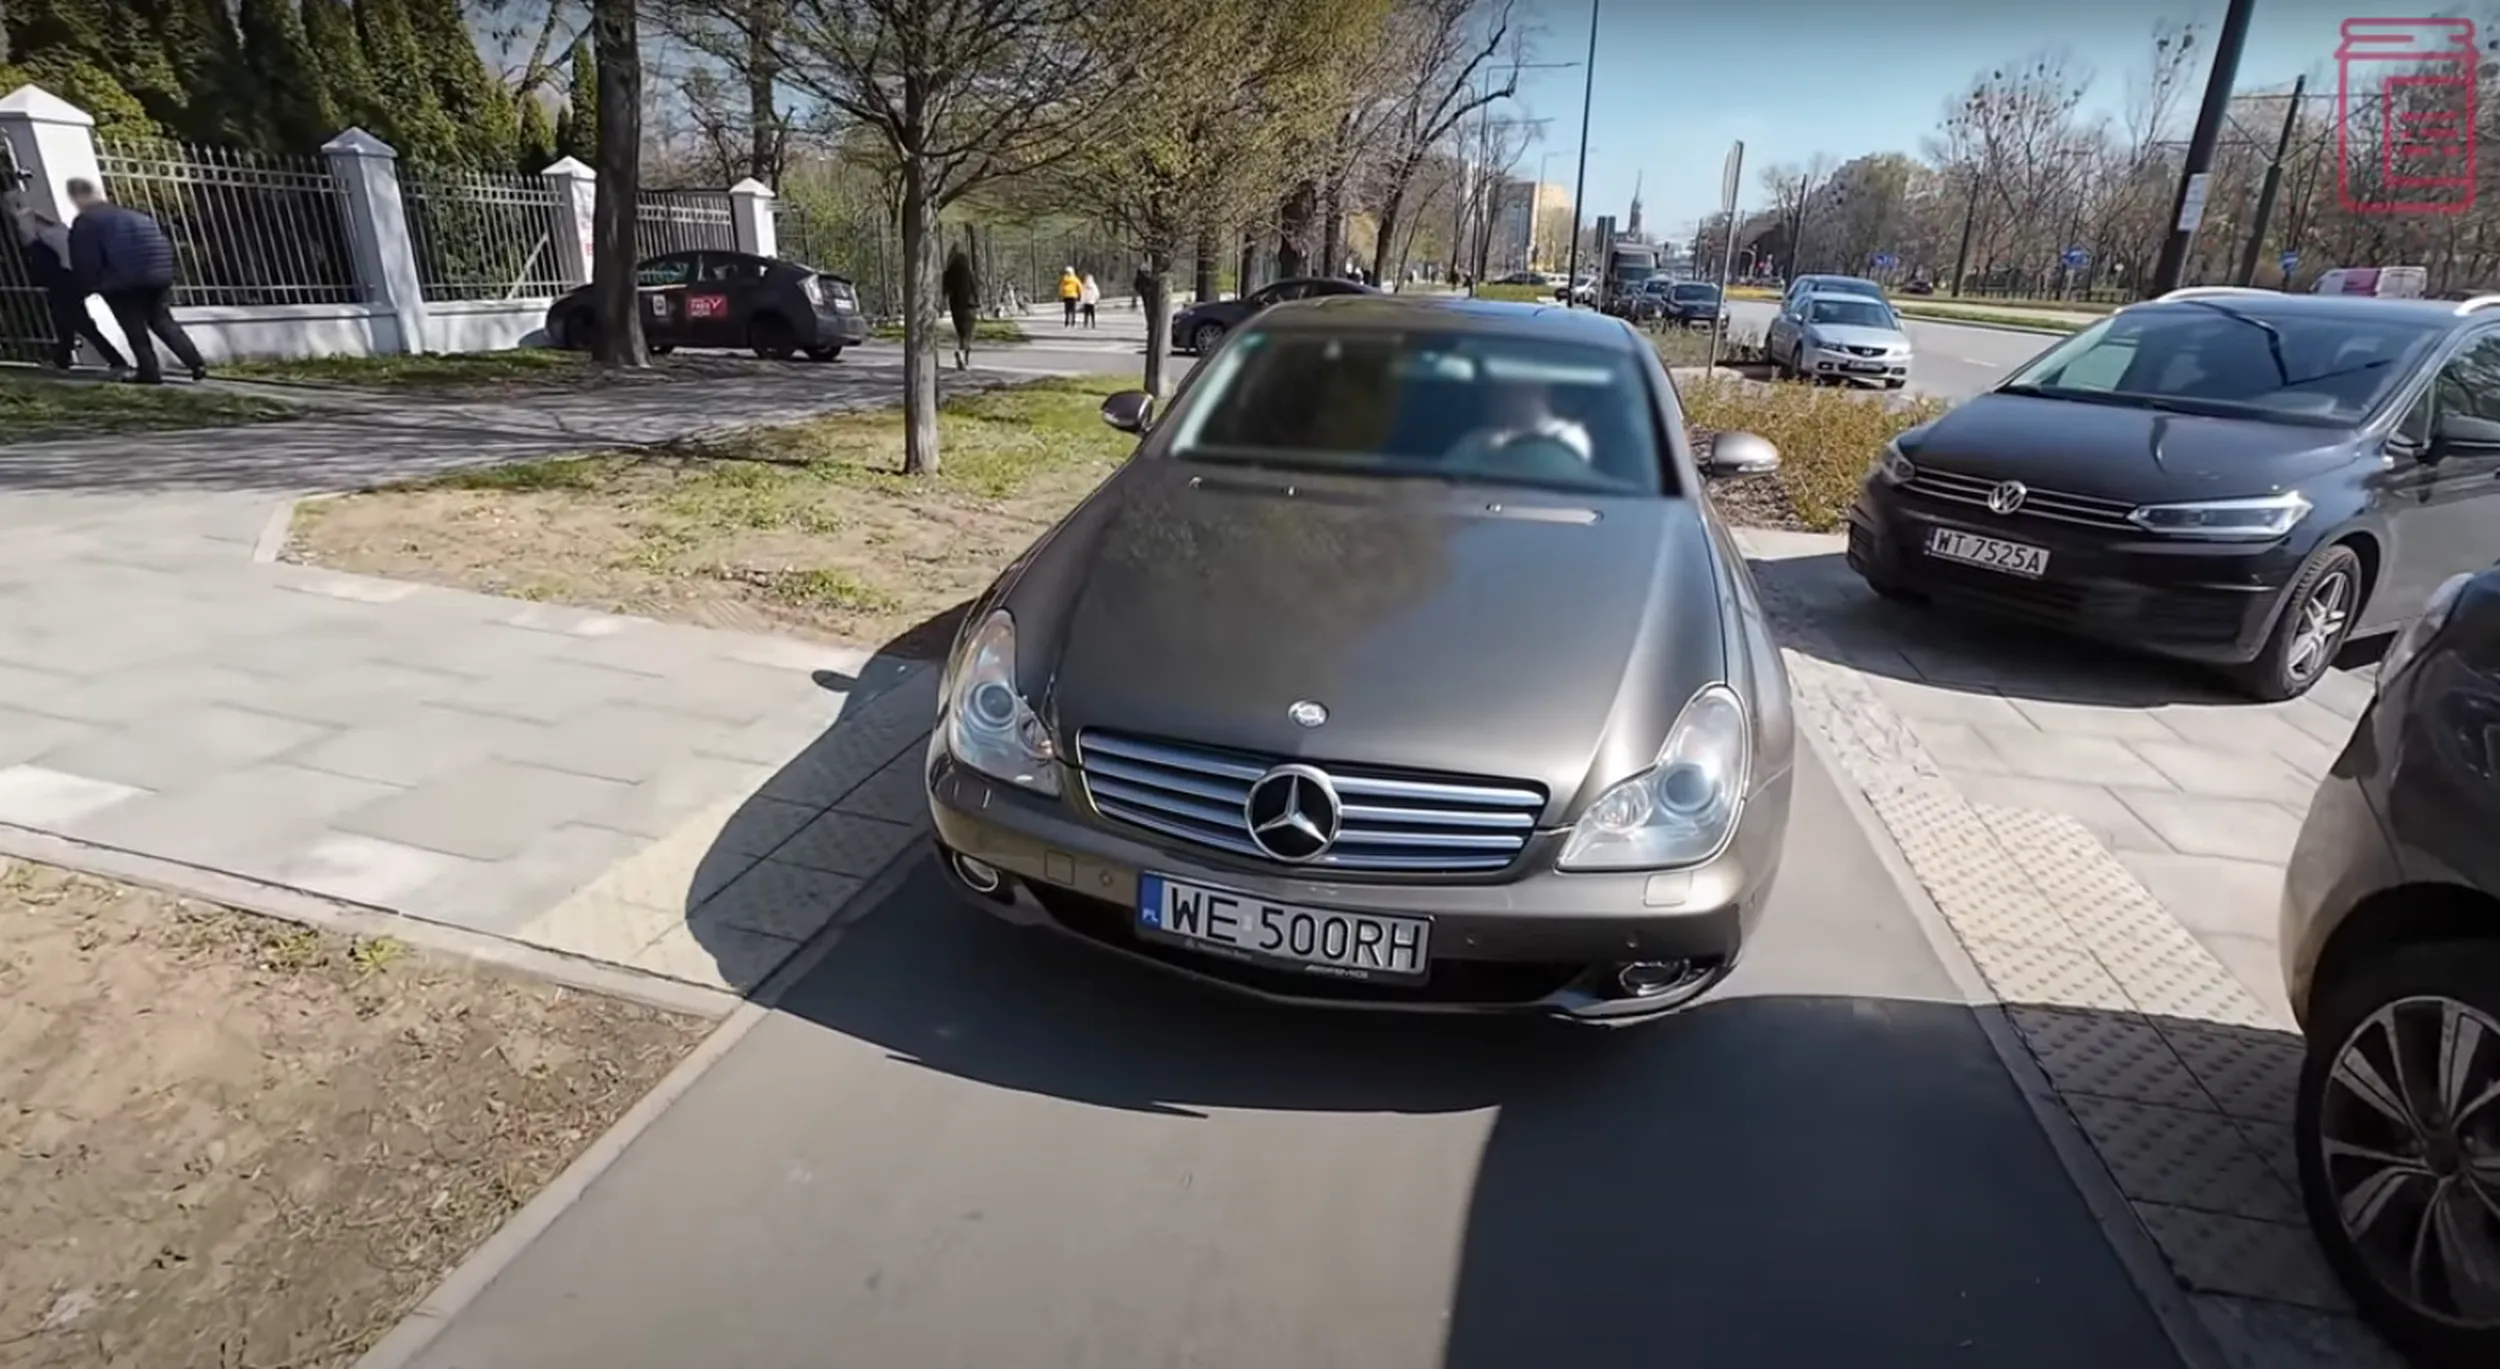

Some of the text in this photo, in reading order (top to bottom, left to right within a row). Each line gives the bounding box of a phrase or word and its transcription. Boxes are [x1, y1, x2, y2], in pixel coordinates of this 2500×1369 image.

[1937, 530, 2040, 572] WT 7525A
[1142, 908, 1159, 923] PL
[1171, 886, 1421, 969] WE 500RH
